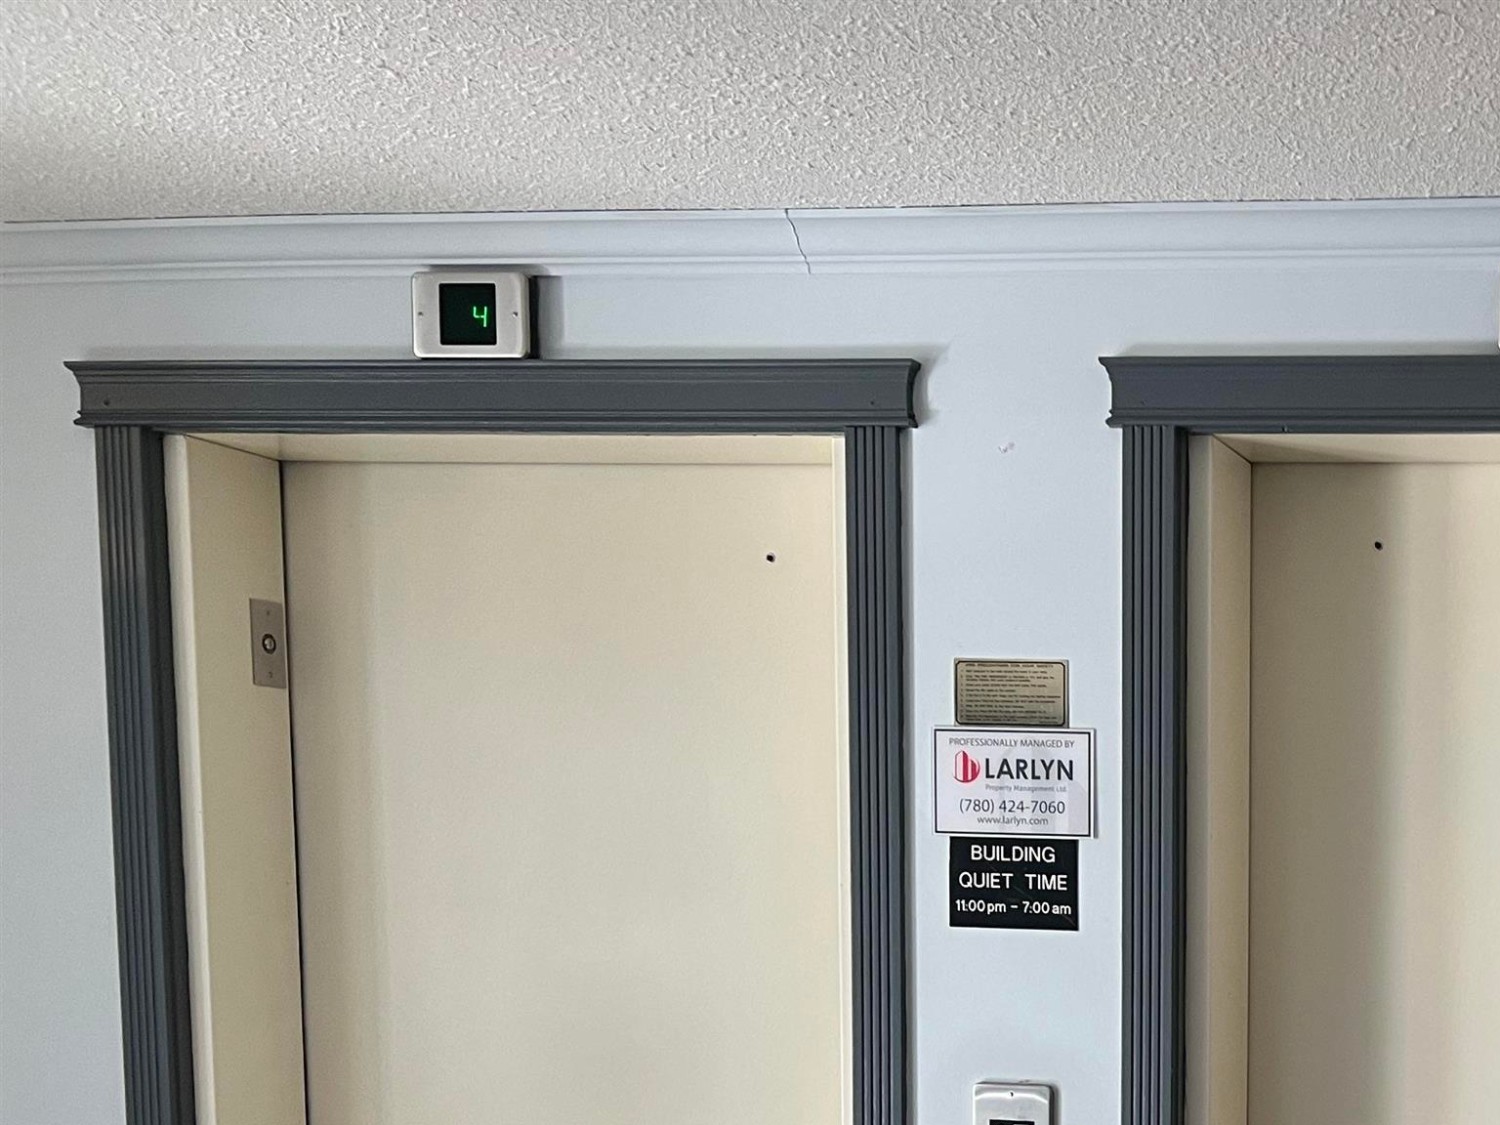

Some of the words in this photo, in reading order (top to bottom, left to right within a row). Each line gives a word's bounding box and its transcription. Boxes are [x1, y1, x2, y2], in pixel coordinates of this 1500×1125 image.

[472, 305, 488, 328] 4
[949, 737, 1018, 748] PROFESSIONALLY
[1020, 739, 1063, 749] MANAGED
[1064, 740, 1075, 749] BY
[985, 757, 1074, 781] LARLYN
[959, 798, 995, 815] (780)
[998, 800, 1066, 815] 424-7060
[977, 815, 1049, 827] www.larlyn.com
[970, 844, 1056, 863] BUILDING
[958, 871, 1014, 889] QUIET
[1024, 873, 1068, 891] TIME
